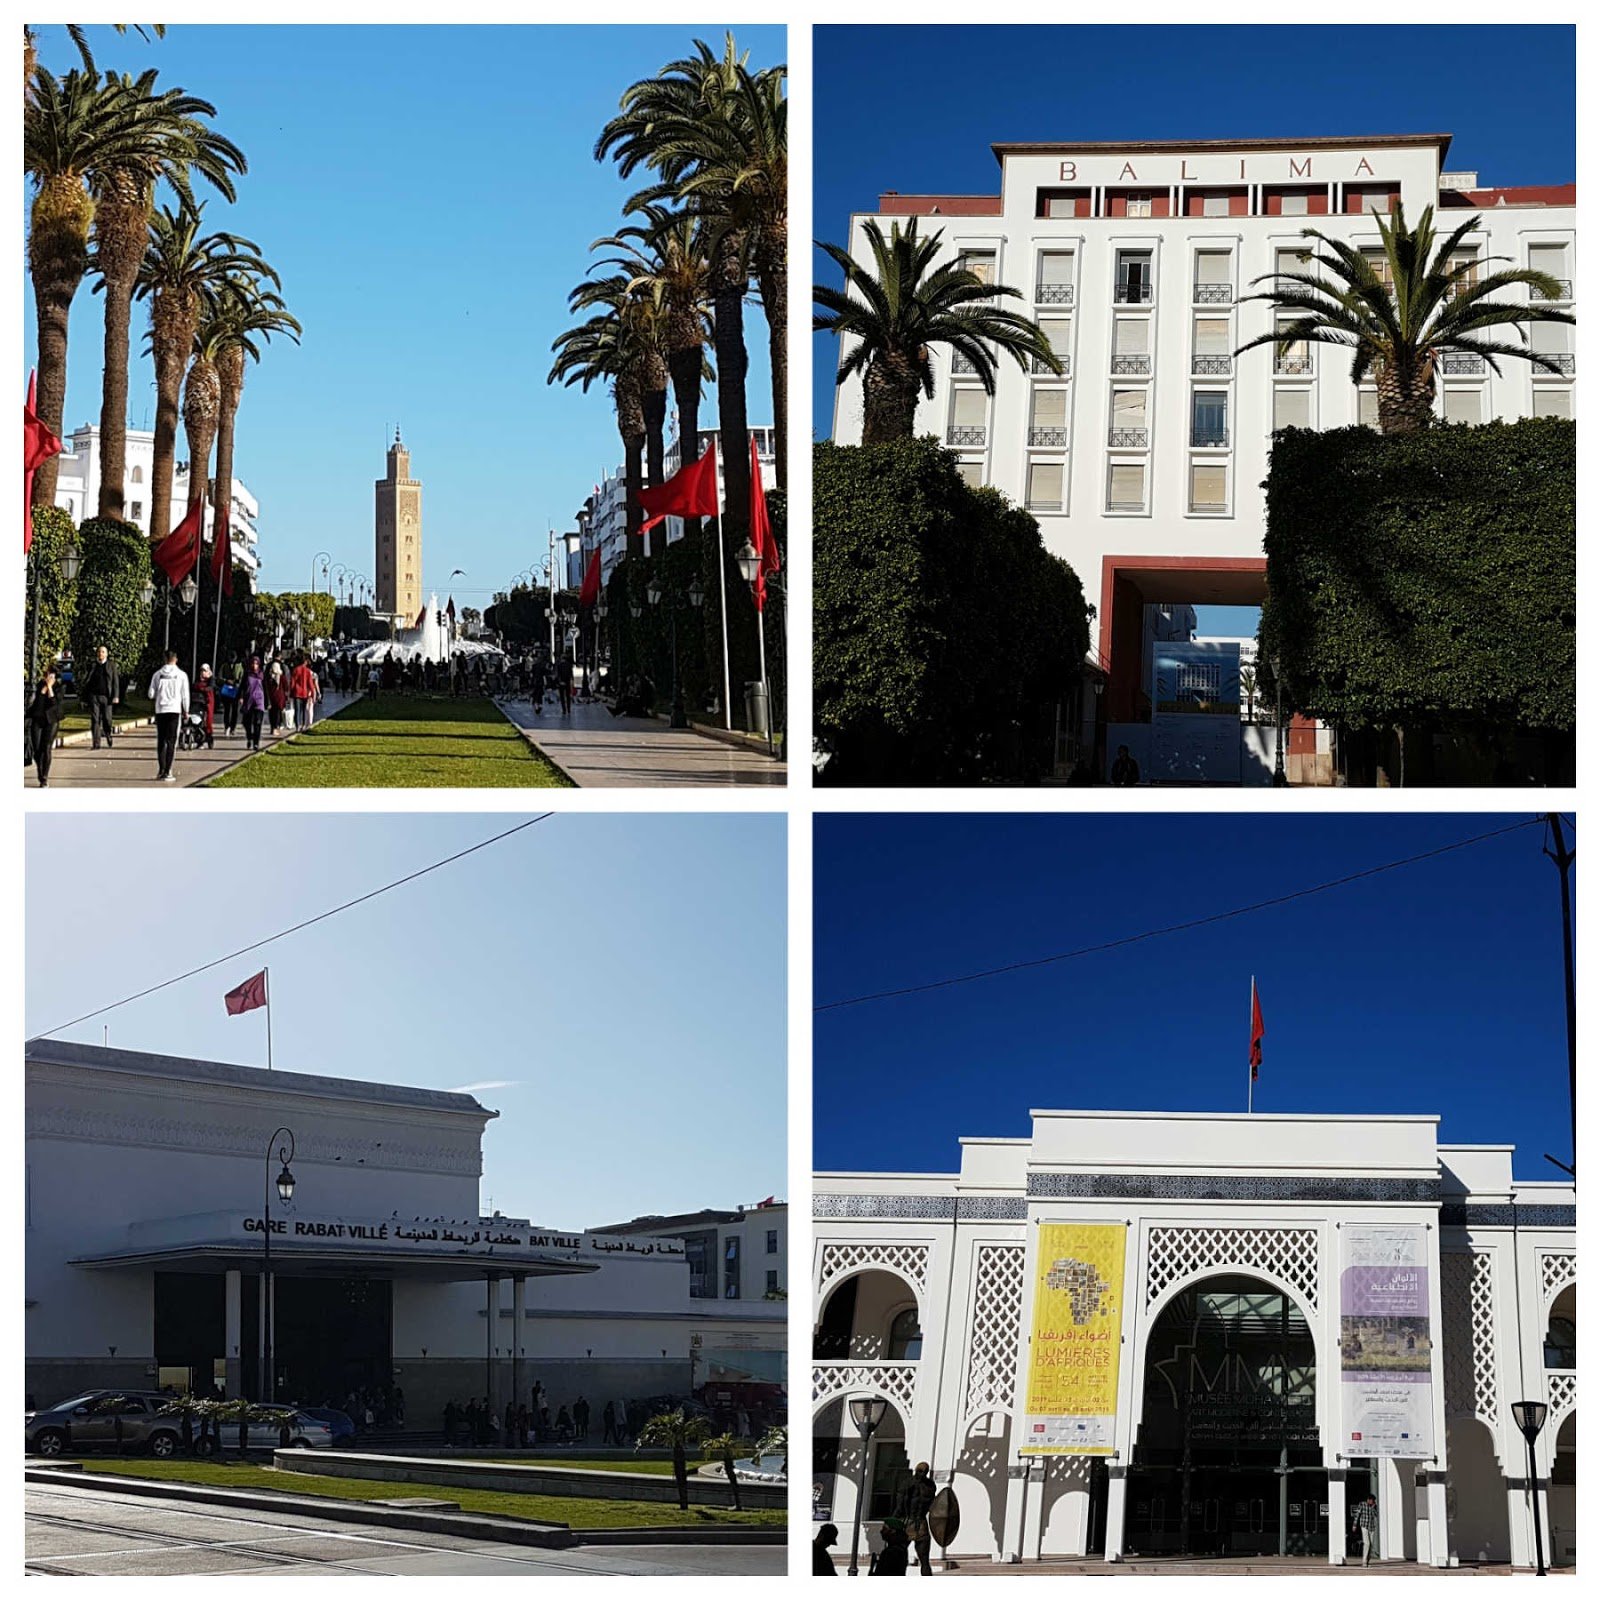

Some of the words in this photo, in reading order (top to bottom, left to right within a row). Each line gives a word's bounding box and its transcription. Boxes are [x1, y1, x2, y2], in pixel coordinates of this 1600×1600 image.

[1059, 157, 1375, 182] BALIMA
[243, 1218, 287, 1234] GARE
[295, 1221, 344, 1237] RABAT
[551, 1237, 580, 1249] VILLE
[1035, 1358, 1110, 1367] D'AFRIQUES
